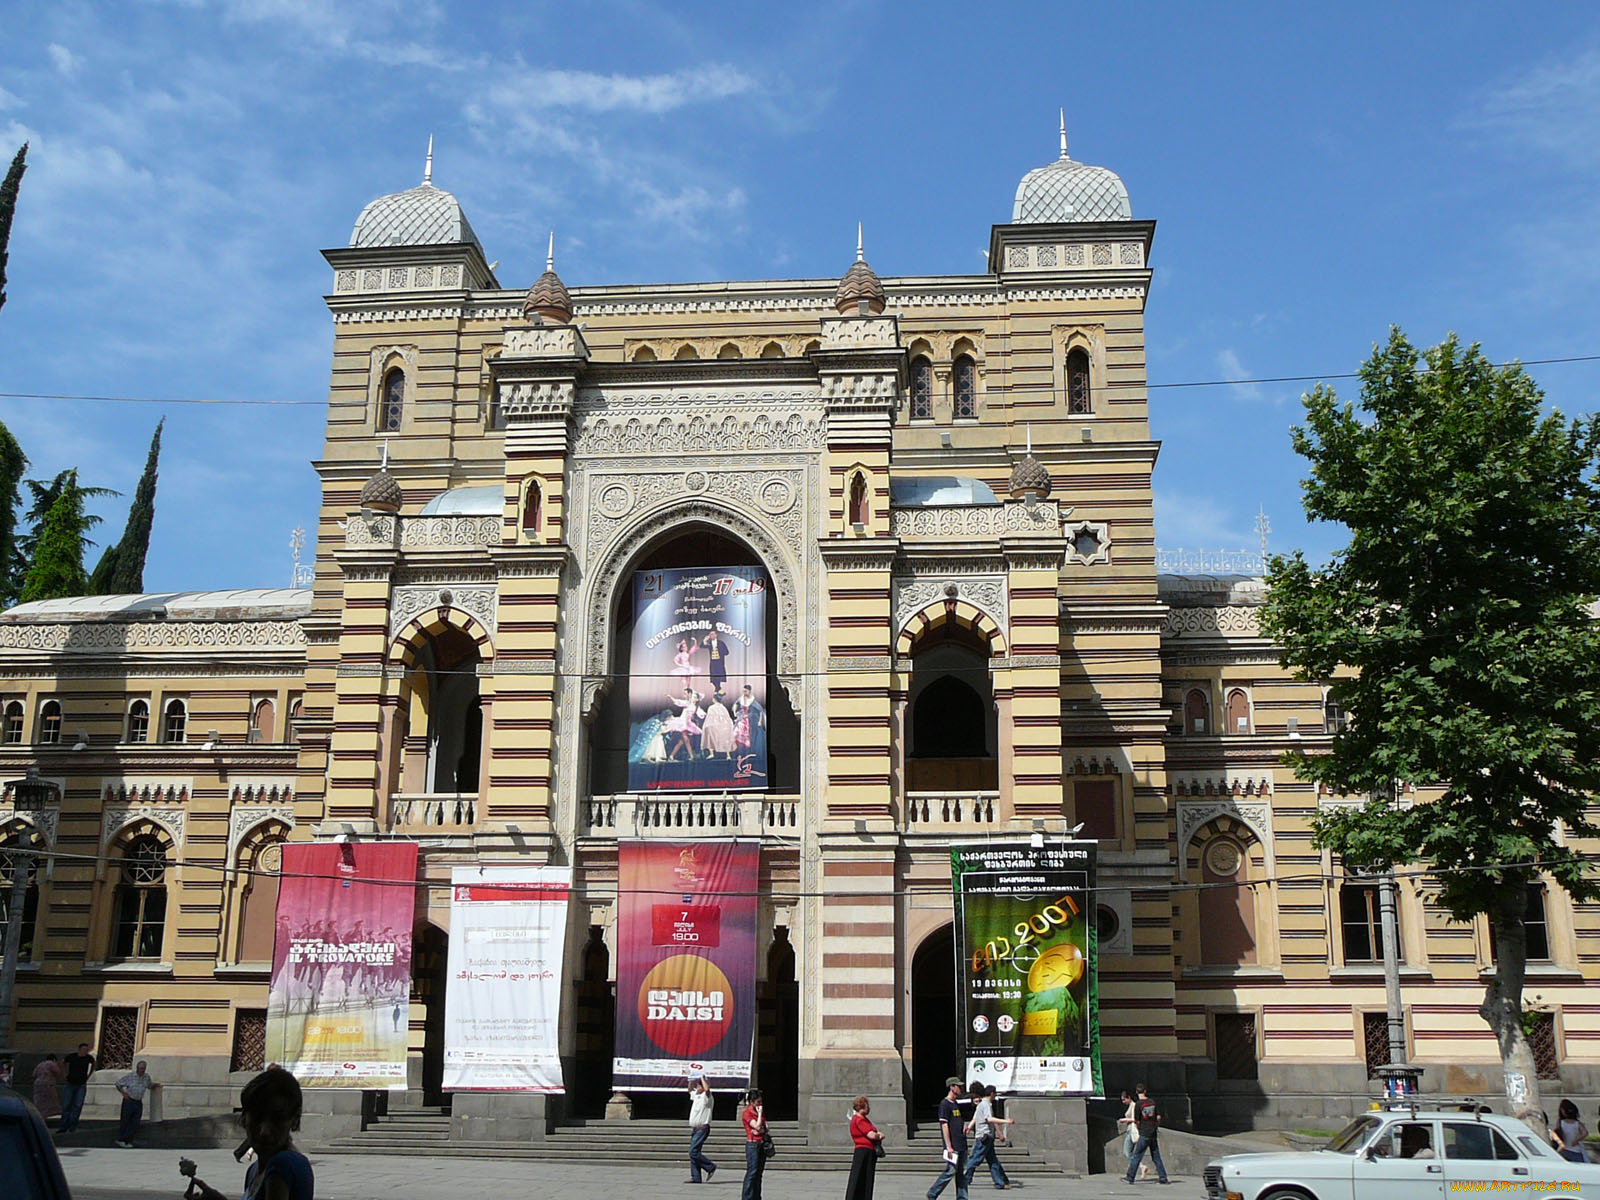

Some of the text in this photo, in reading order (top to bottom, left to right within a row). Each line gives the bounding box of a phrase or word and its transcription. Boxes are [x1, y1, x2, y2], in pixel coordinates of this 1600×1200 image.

[643, 575, 664, 592] 21
[713, 578, 735, 595] 17
[749, 577, 766, 593] 19
[646, 620, 751, 649] თოჯინების ფერია
[960, 850, 1088, 861] საქართველოს პროფესიული
[984, 860, 1064, 869] ფეხბურთის ლიგა
[681, 911, 688, 922] 7
[1014, 895, 1080, 944] 2007
[290, 942, 395, 954] ტრუბადური
[289, 953, 394, 963] IL TROVATORE
[972, 979, 1021, 988] 19 ივნისი
[648, 990, 724, 1006] დაისი
[647, 1006, 724, 1021] DAISI
